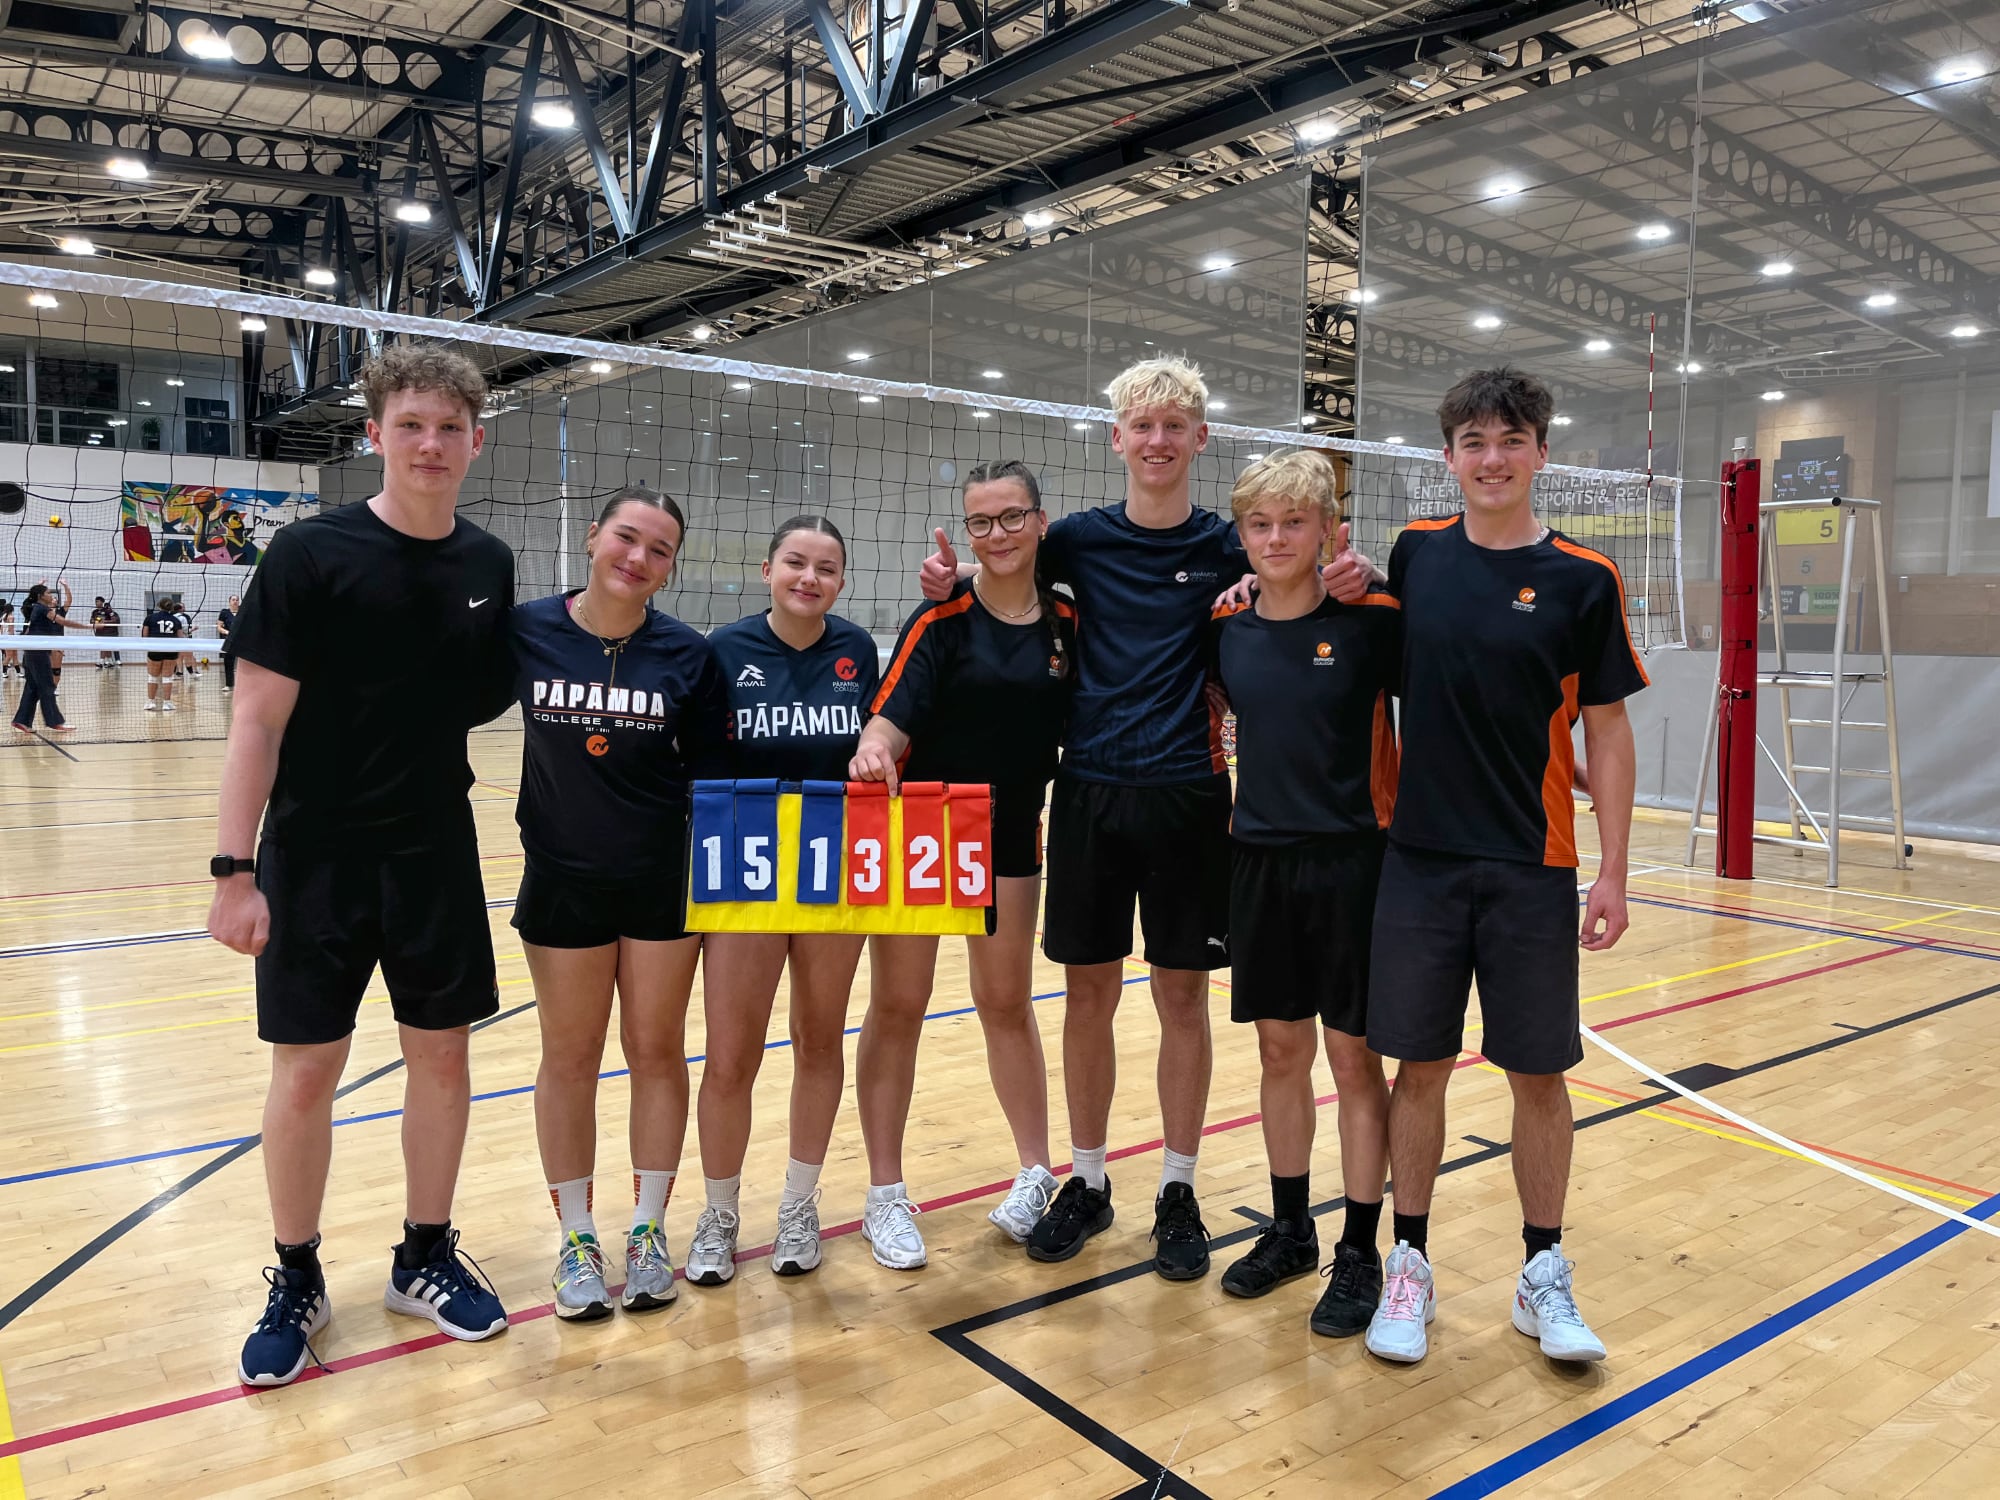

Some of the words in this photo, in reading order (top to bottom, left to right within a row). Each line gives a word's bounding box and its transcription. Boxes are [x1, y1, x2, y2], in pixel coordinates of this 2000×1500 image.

[1535, 489, 1593, 508] SPORTS
[1598, 488, 1610, 504] &
[1820, 519, 1833, 538] 5
[1801, 560, 1810, 574] 5
[157, 619, 174, 634] 12
[736, 680, 766, 688] RIVAL
[533, 679, 665, 717] PĀPĀMOA
[533, 712, 602, 726] COLLEGE
[614, 719, 665, 732] SPORT
[736, 701, 862, 741] PĀPĀMOA
